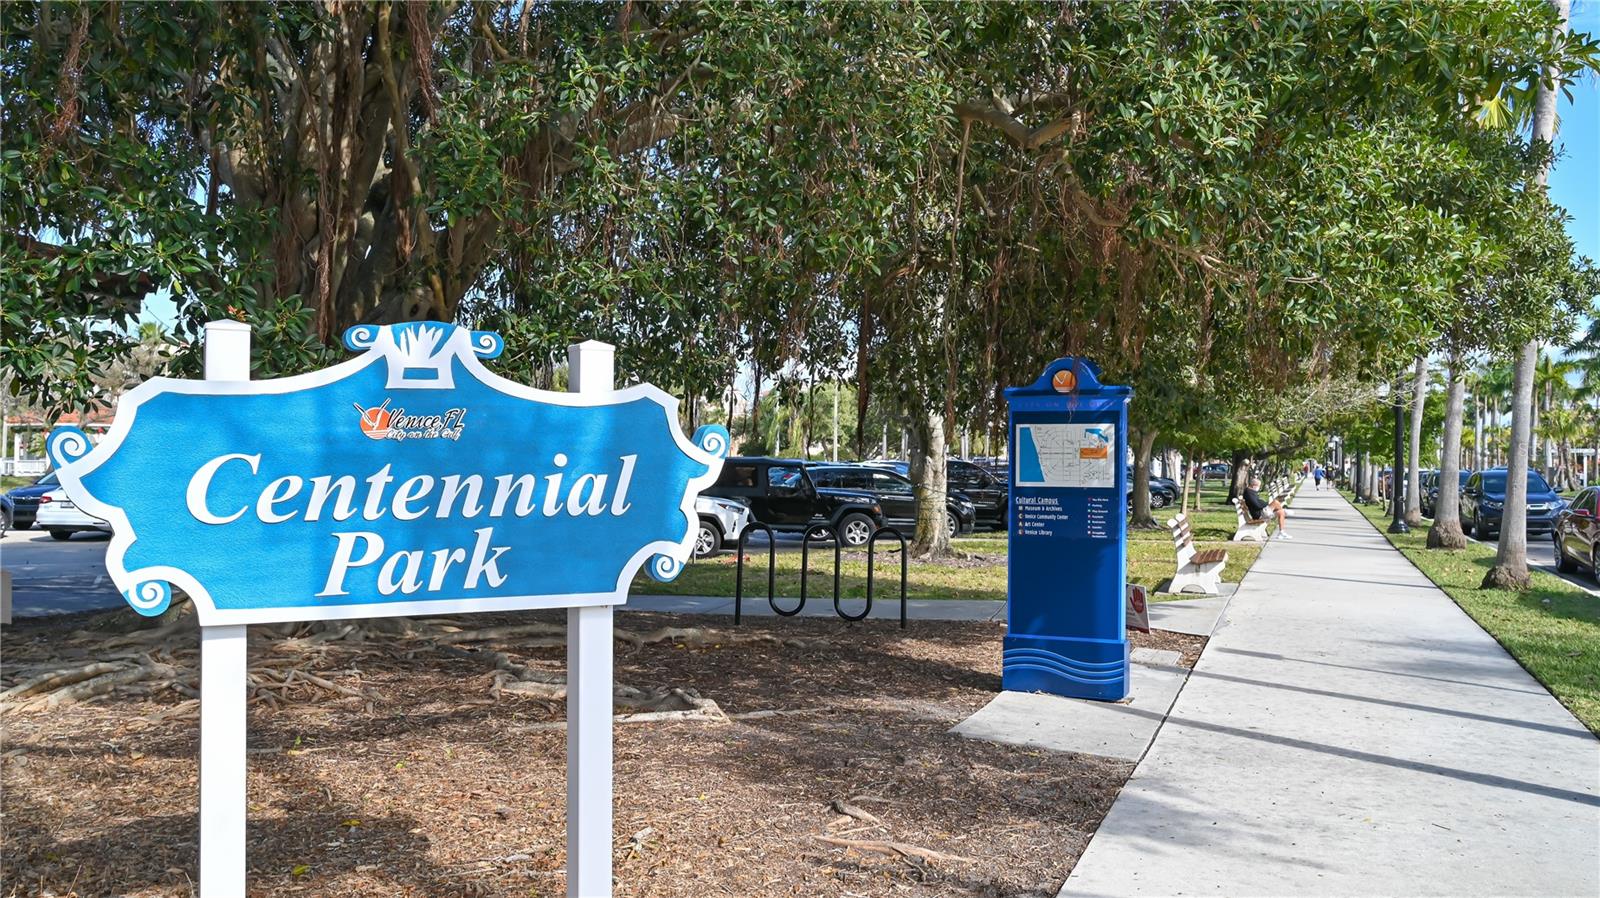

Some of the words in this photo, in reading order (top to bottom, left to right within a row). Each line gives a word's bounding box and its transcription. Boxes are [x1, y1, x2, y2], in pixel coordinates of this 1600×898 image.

[386, 428, 406, 441] City
[407, 430, 422, 439] on
[423, 428, 438, 439] the
[441, 428, 462, 441] Gulf
[186, 453, 637, 525] Centennial
[1037, 497, 1058, 505] Campus
[315, 527, 511, 597] Park
